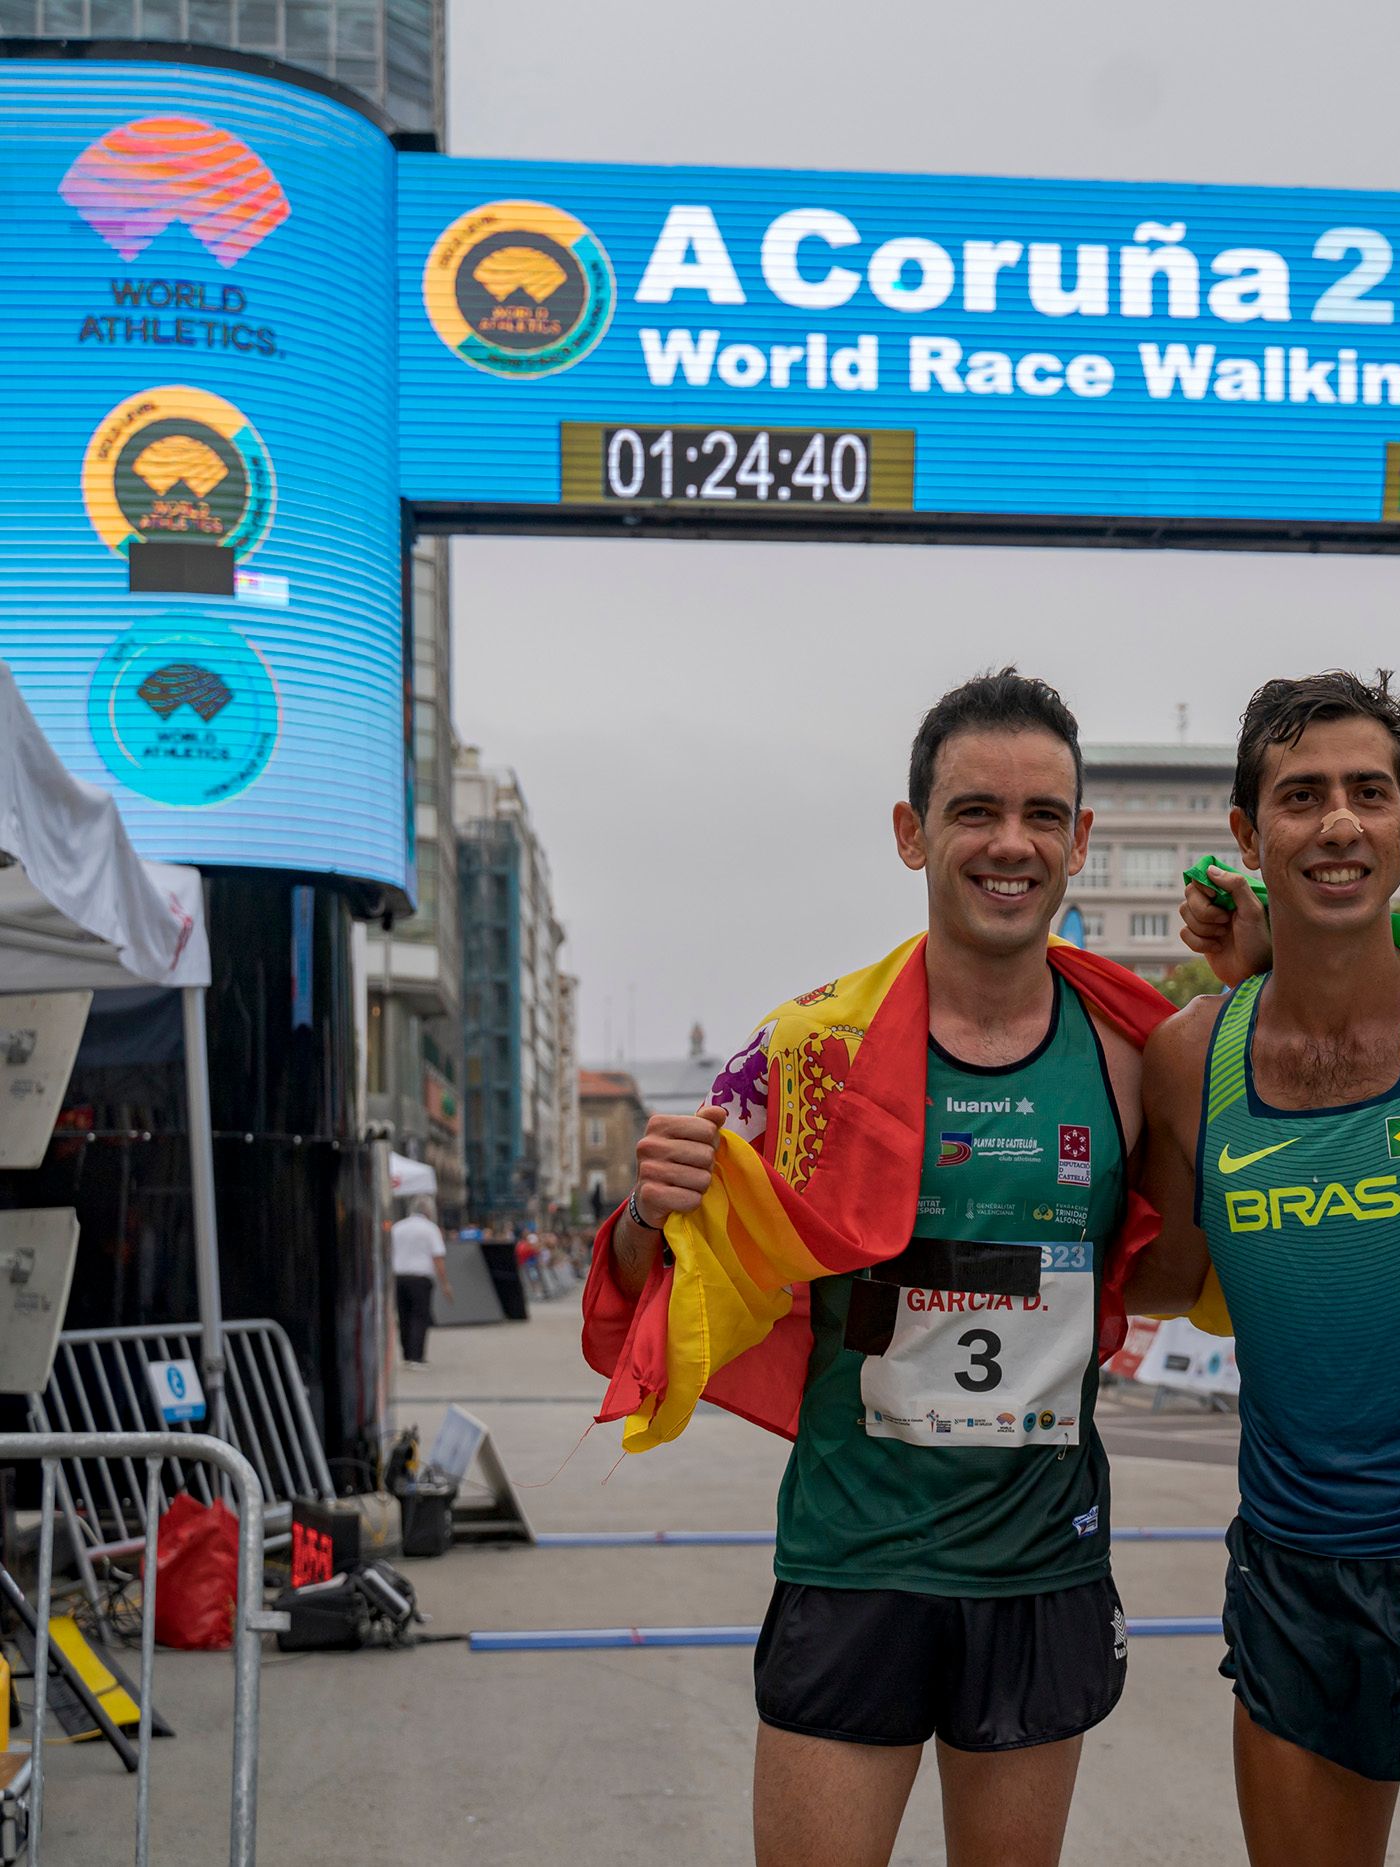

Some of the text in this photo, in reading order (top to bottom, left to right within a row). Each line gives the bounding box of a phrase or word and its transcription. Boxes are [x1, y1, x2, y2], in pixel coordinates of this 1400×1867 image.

[634, 204, 748, 305] A
[759, 207, 1293, 323] Coruña
[111, 280, 248, 313] WORLD
[638, 327, 879, 391] World
[909, 336, 1116, 398] Race
[607, 428, 867, 502] 01:24:40
[946, 1096, 1012, 1113] luanvi
[973, 1136, 1038, 1149] PLAYAS DE CASTELLÓN
[1054, 1216, 1087, 1227] ALFONSO
[1055, 1208, 1088, 1220] TRINIDAD
[954, 1328, 1003, 1393] 3
